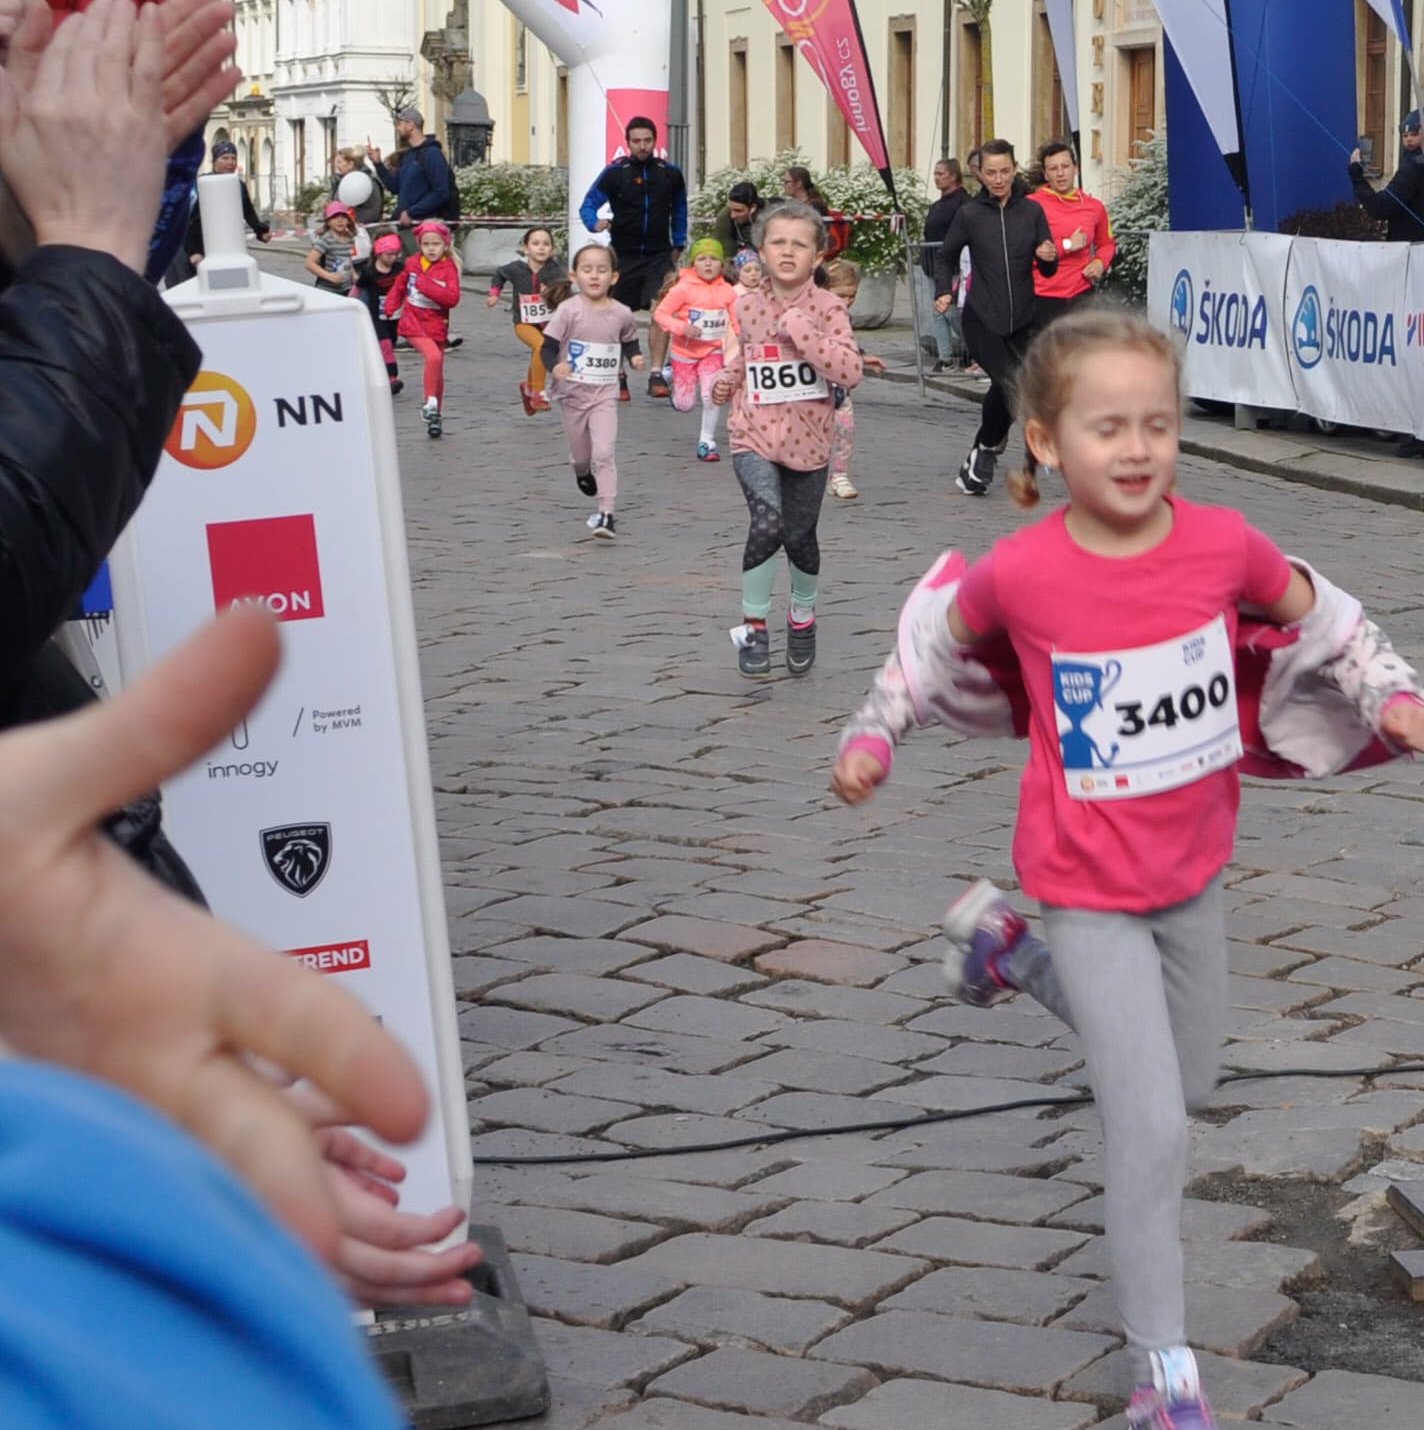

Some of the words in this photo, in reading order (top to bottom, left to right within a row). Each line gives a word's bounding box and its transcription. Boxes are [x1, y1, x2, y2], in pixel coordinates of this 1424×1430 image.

[1196, 279, 1267, 349] ŠKODA
[1326, 295, 1397, 366] ŠKODA
[585, 356, 618, 369] 3380
[749, 361, 818, 391] 1860
[273, 391, 345, 428] NN
[312, 705, 362, 721] Powered
[1114, 672, 1230, 737] 3400
[313, 721, 328, 734] by
[332, 718, 362, 731] MVM
[208, 760, 279, 780] innogy
[266, 827, 325, 842] PEUGEOT
